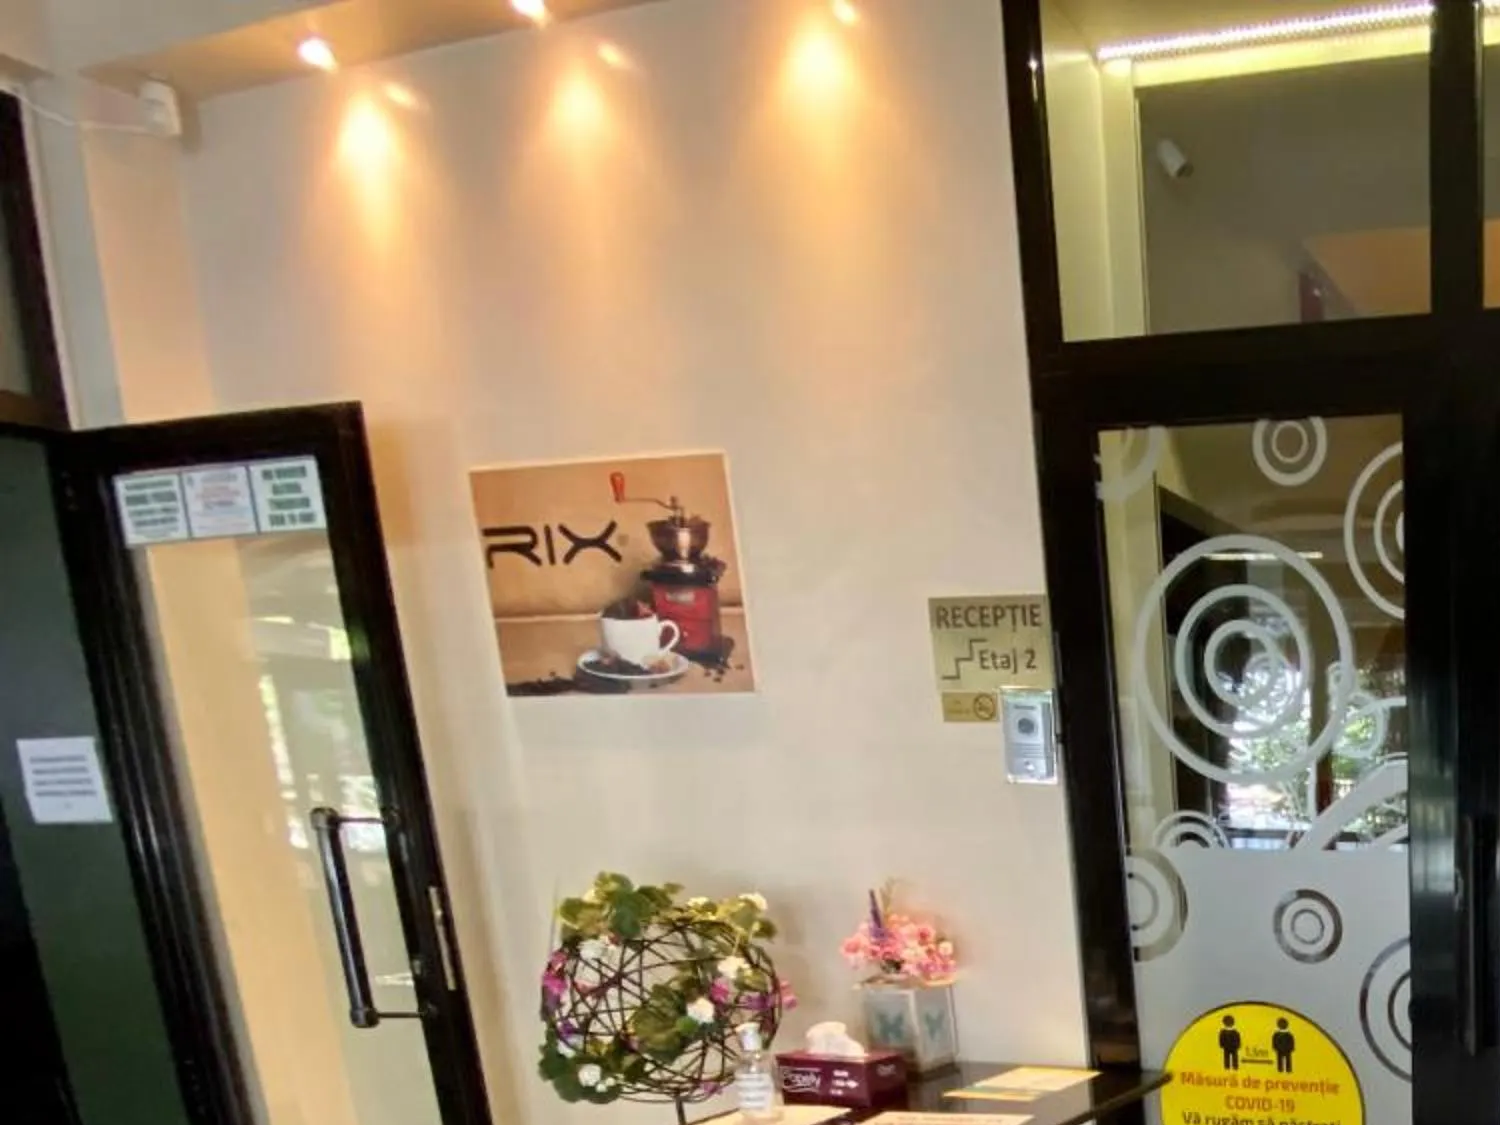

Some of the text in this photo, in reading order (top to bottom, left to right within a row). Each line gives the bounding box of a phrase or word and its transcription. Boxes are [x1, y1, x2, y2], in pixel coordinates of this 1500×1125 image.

[481, 520, 623, 569] RIX
[935, 604, 1044, 633] RECEPȚIE
[978, 647, 1038, 675] Etaj 2
[1180, 1071, 1239, 1088] Măsură
[1243, 1075, 1261, 1089] de
[1182, 1111, 1201, 1125] Vă
